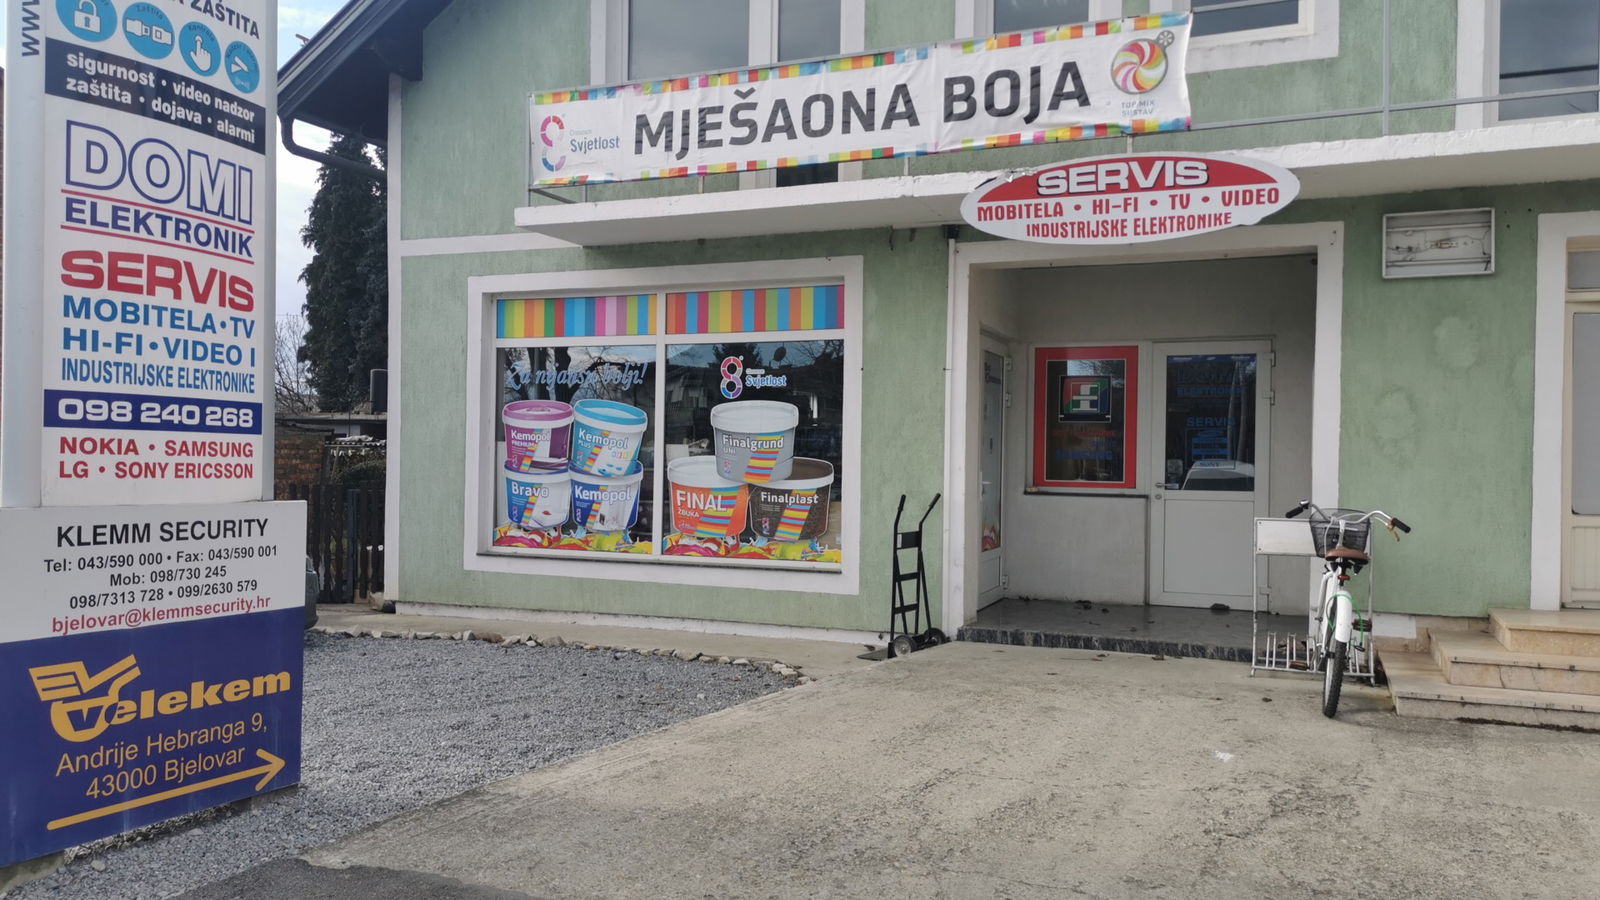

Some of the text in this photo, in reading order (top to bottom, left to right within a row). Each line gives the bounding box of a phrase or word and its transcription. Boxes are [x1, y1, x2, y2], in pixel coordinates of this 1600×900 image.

[190, 0, 260, 40] ZAŠTITA
[66, 52, 255, 122] sigurnost video nadzor
[66, 76, 256, 144] zaštita dojava alarmi
[633, 60, 1092, 161] MJEŠAONA BOJA
[570, 136, 620, 154] Svjetlost
[66, 119, 253, 226] DOMI
[1037, 160, 1210, 198] SERVIS
[977, 187, 1280, 222] MOBITELA HI-FI TV VIDEO
[65, 197, 253, 258] ELEKTRONIK
[1026, 212, 1232, 239] INDUSTRIJSKE ELEKTRONIKE
[61, 250, 254, 312] SERVIS
[63, 294, 255, 339] MOBITELA TV
[63, 327, 256, 367] HI-FI VIDEO I
[62, 357, 255, 394] INDUSTRIJSKE ELEKTRONIKE
[745, 374, 787, 389] Svjetlost
[58, 398, 254, 428] 098 240 268
[59, 436, 254, 458] NOKIA SAMSUNG
[511, 429, 551, 442] Kemopol
[577, 440, 592, 449] PLUS
[578, 428, 629, 449] Kemopol
[721, 434, 785, 451] Finalgrund
[59, 460, 254, 479] LG SONY ERICSSON
[511, 481, 549, 497] Bravo
[574, 485, 632, 505] Kemopol
[675, 488, 727, 513] FINAL
[760, 491, 820, 507] Finalplast
[57, 518, 269, 547] KLEMM SECURITY
[44, 545, 278, 573] Tel: 043/590 000 Fax: 043/590 001
[109, 565, 227, 587] Mob: 098/730 245
[70, 579, 258, 609] 098/7313 728 099/2630 579
[52, 595, 271, 636] bjelovar@klemmsecurity.hr
[55, 712, 268, 777] Andrije Hebranga 9,
[86, 747, 246, 800] 43000 Bjelovar
